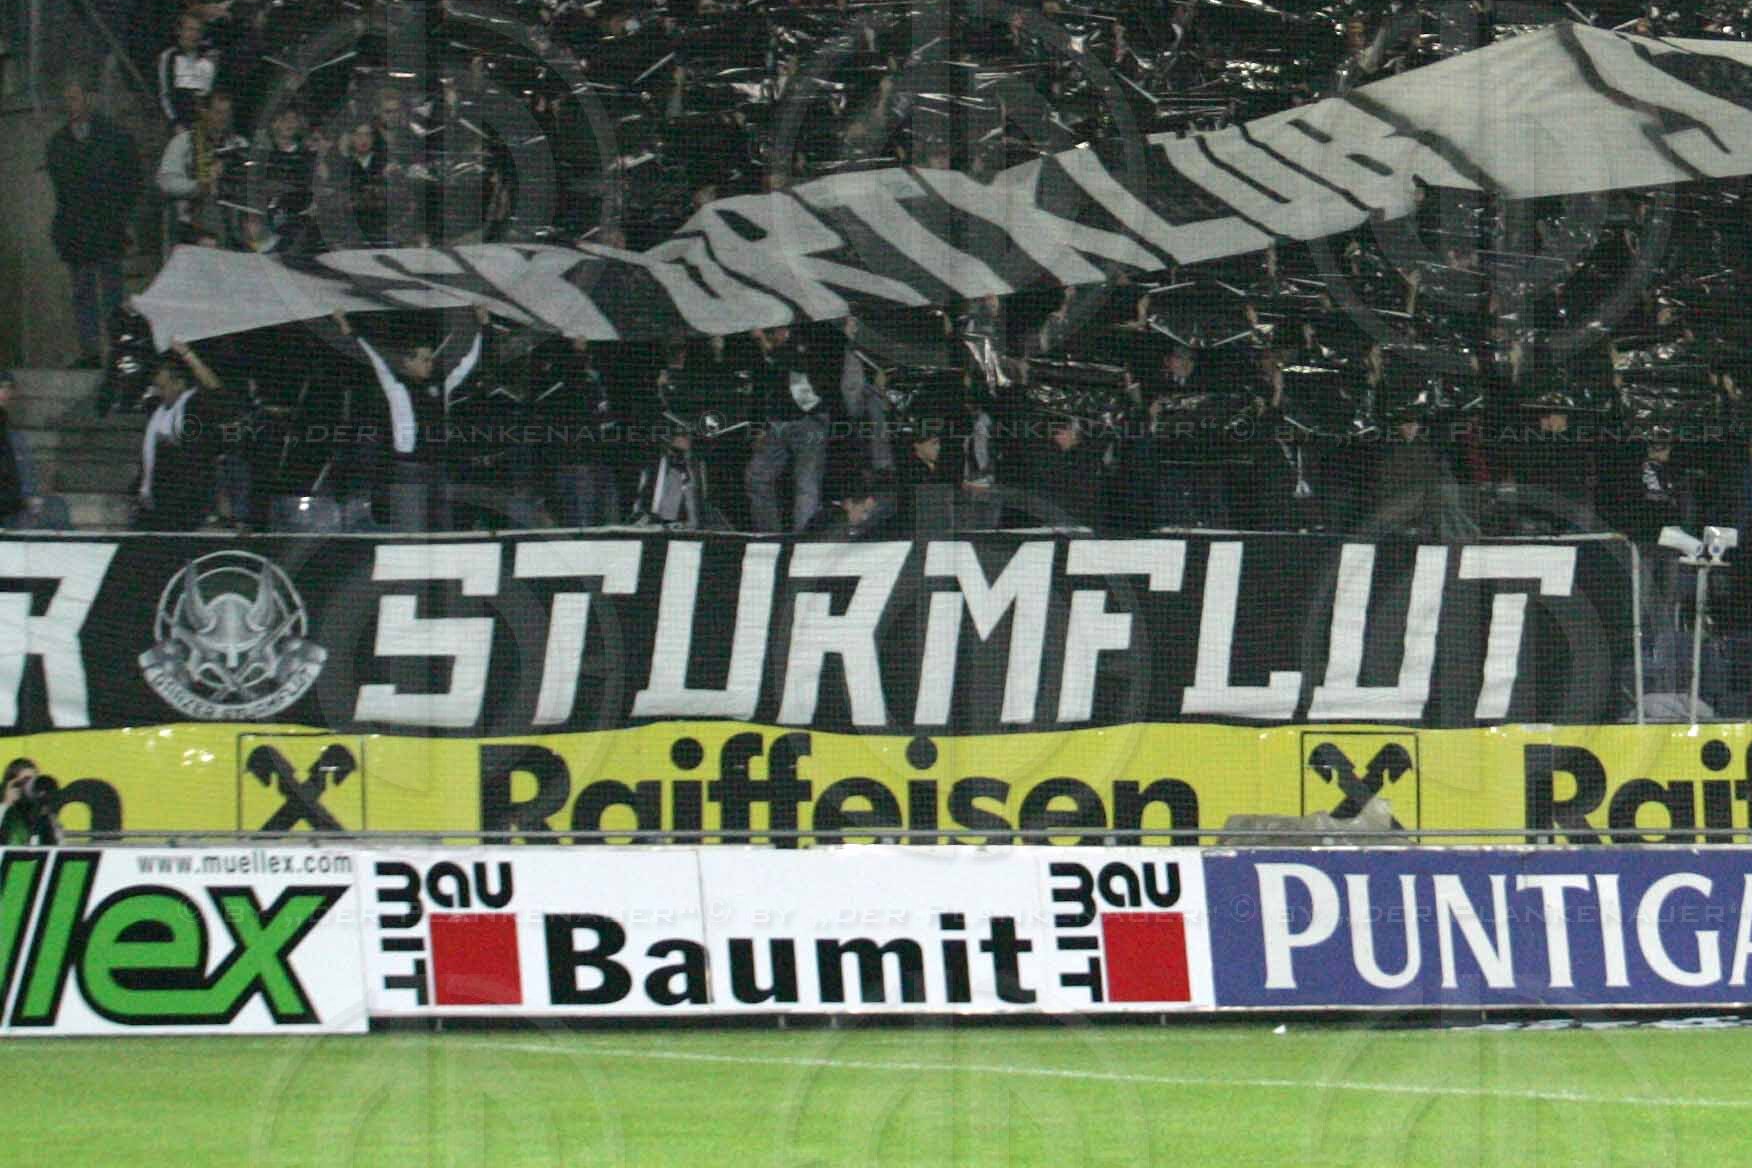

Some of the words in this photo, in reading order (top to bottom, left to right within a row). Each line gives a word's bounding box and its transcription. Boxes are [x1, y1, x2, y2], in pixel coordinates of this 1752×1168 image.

[353, 539, 1577, 729] STURMFLUT
[479, 731, 1199, 845] Raiffeisen
[137, 851, 354, 875] www.muellex.com
[543, 911, 1037, 1005] Baumit
